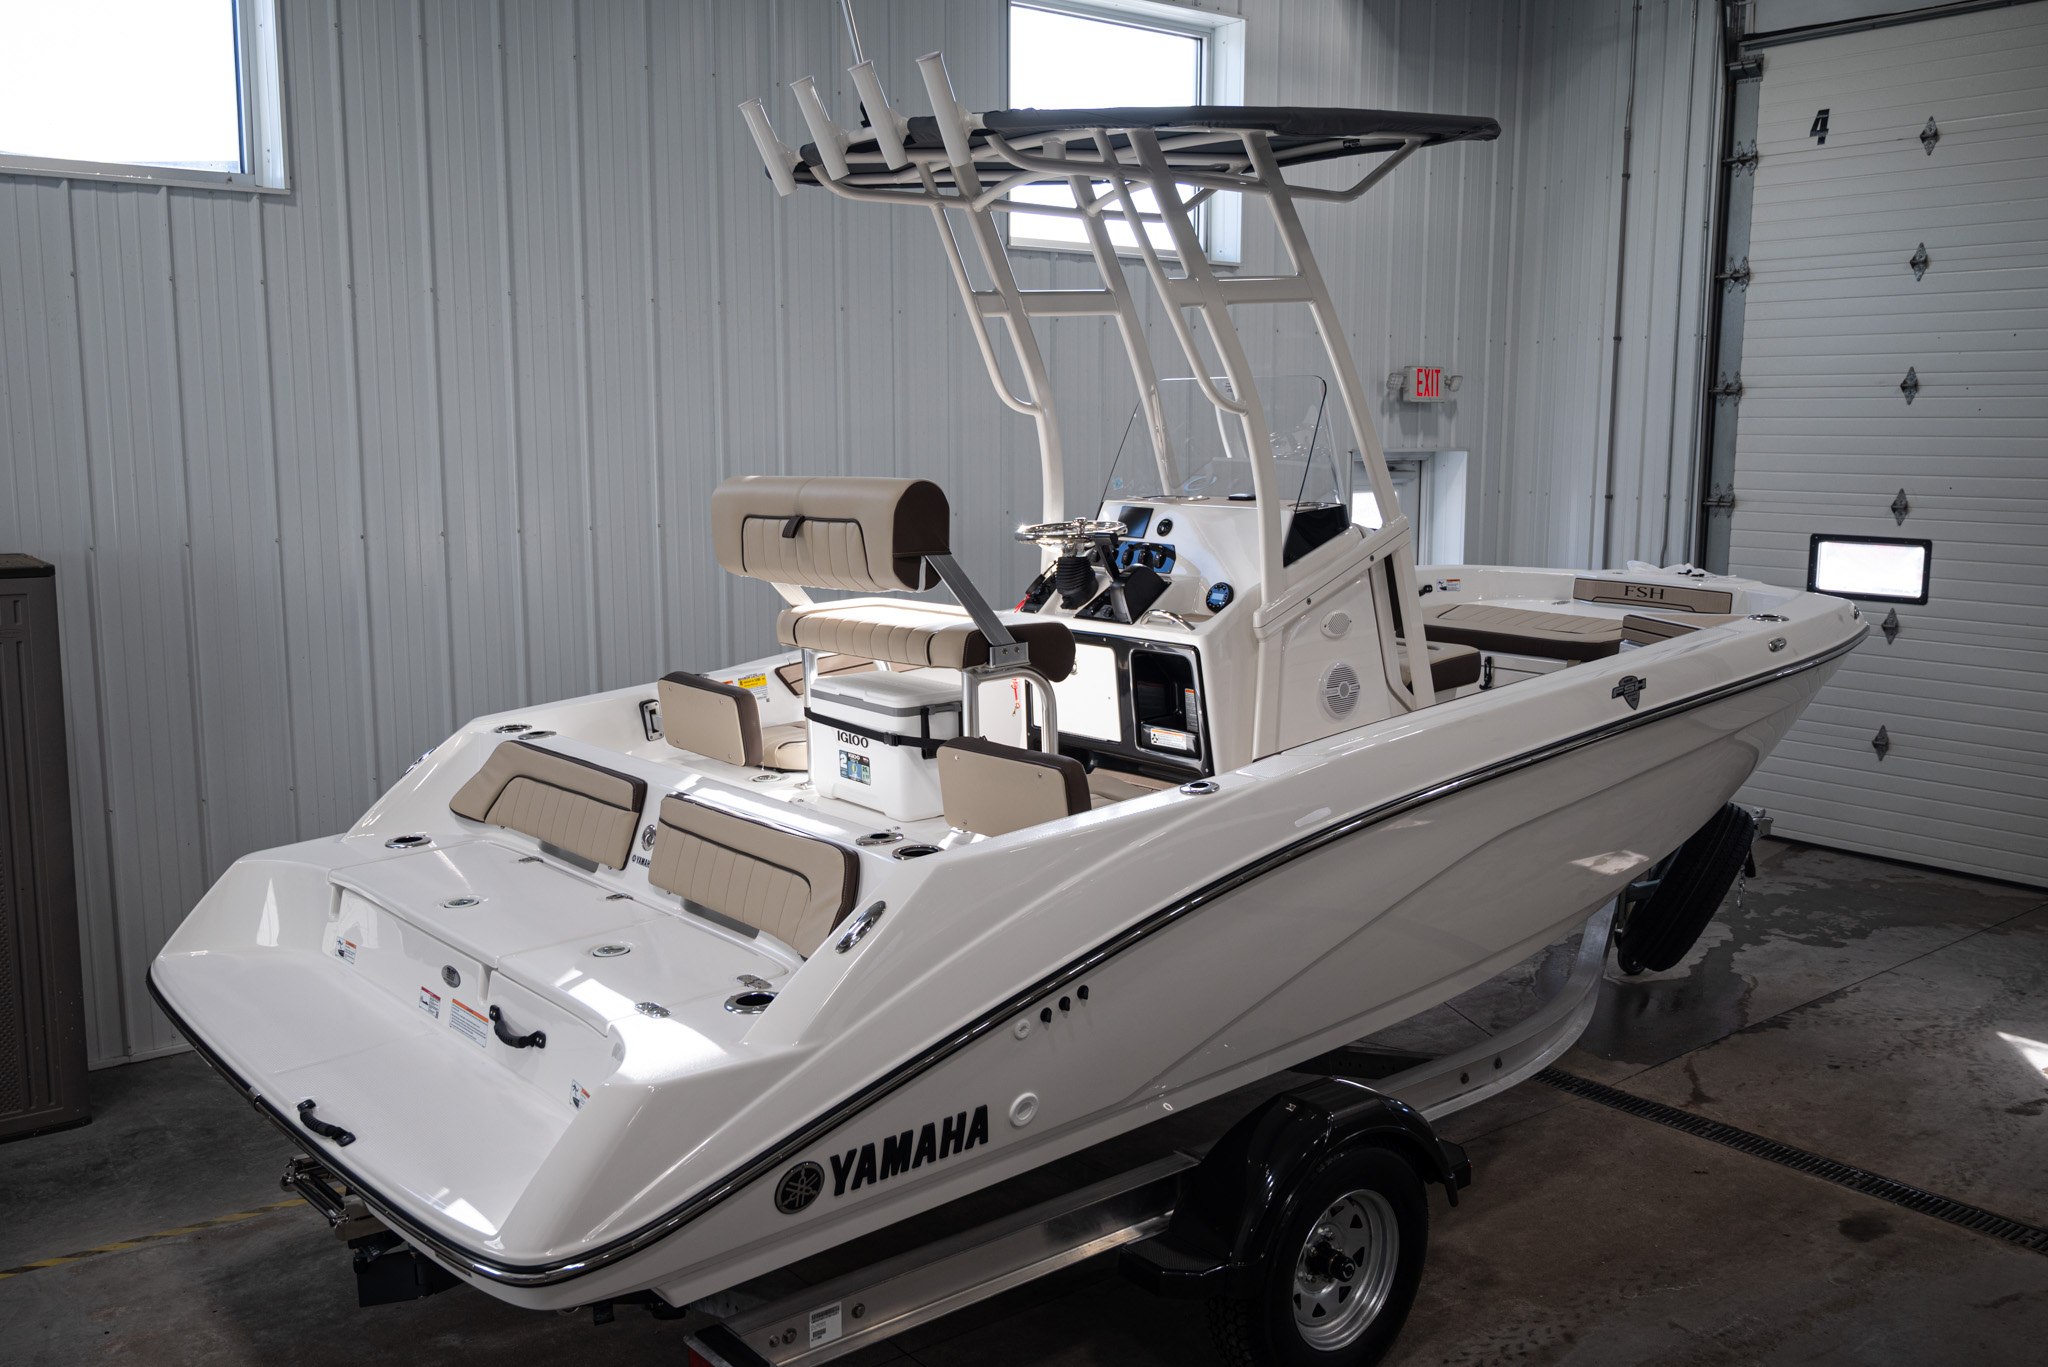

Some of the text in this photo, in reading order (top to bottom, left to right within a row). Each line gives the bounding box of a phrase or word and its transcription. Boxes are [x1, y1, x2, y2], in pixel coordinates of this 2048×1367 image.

[1809, 108, 1830, 145] 4
[1416, 368, 1441, 397] EXIT
[1624, 585, 1664, 600] FSH
[1612, 678, 1646, 698] FSH
[837, 730, 868, 748] IGLOO
[829, 1104, 989, 1197] YAMAHA
